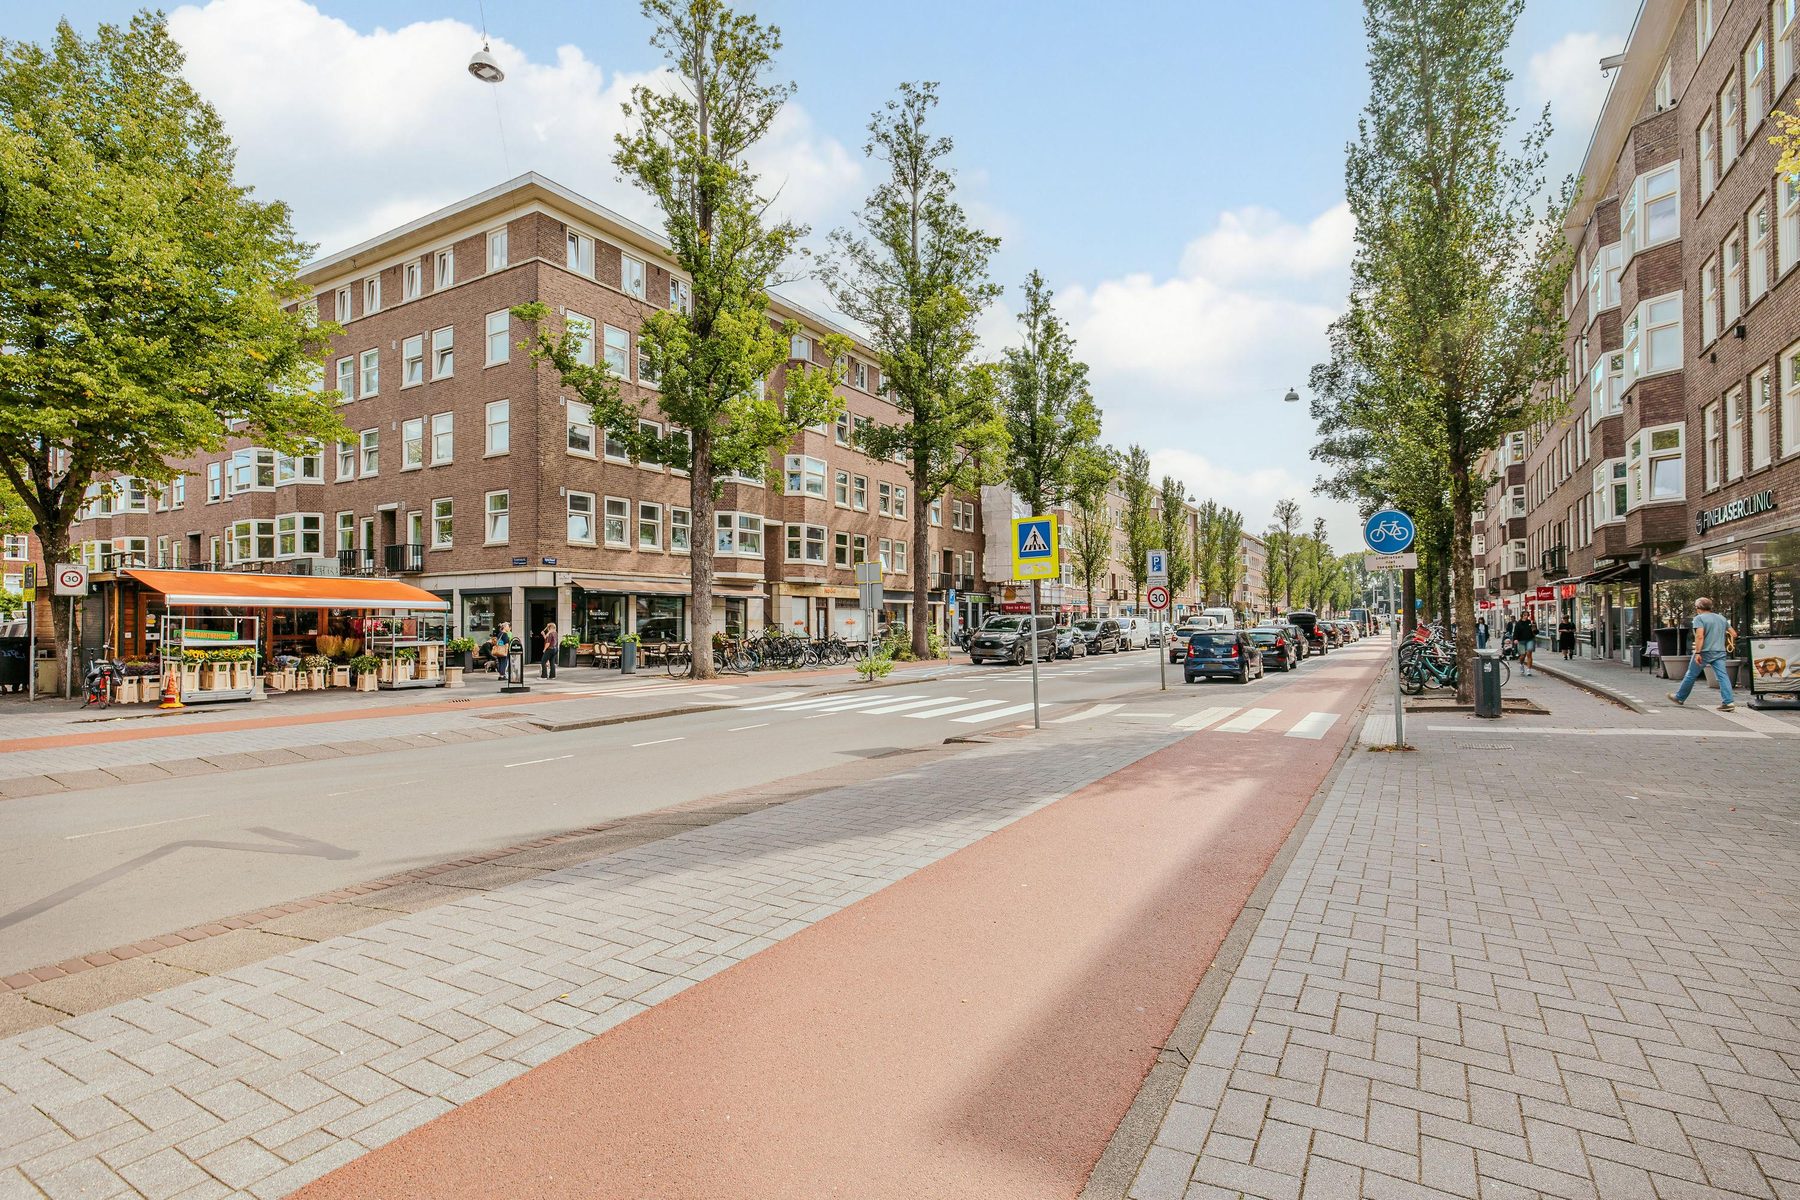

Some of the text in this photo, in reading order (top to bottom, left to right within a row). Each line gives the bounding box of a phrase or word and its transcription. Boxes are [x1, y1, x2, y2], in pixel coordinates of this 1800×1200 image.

[1703, 489, 1773, 529] FINELASERCLINIC
[1153, 556, 1160, 566] P
[64, 575, 79, 583] 30
[1151, 593, 1166, 603] 30
